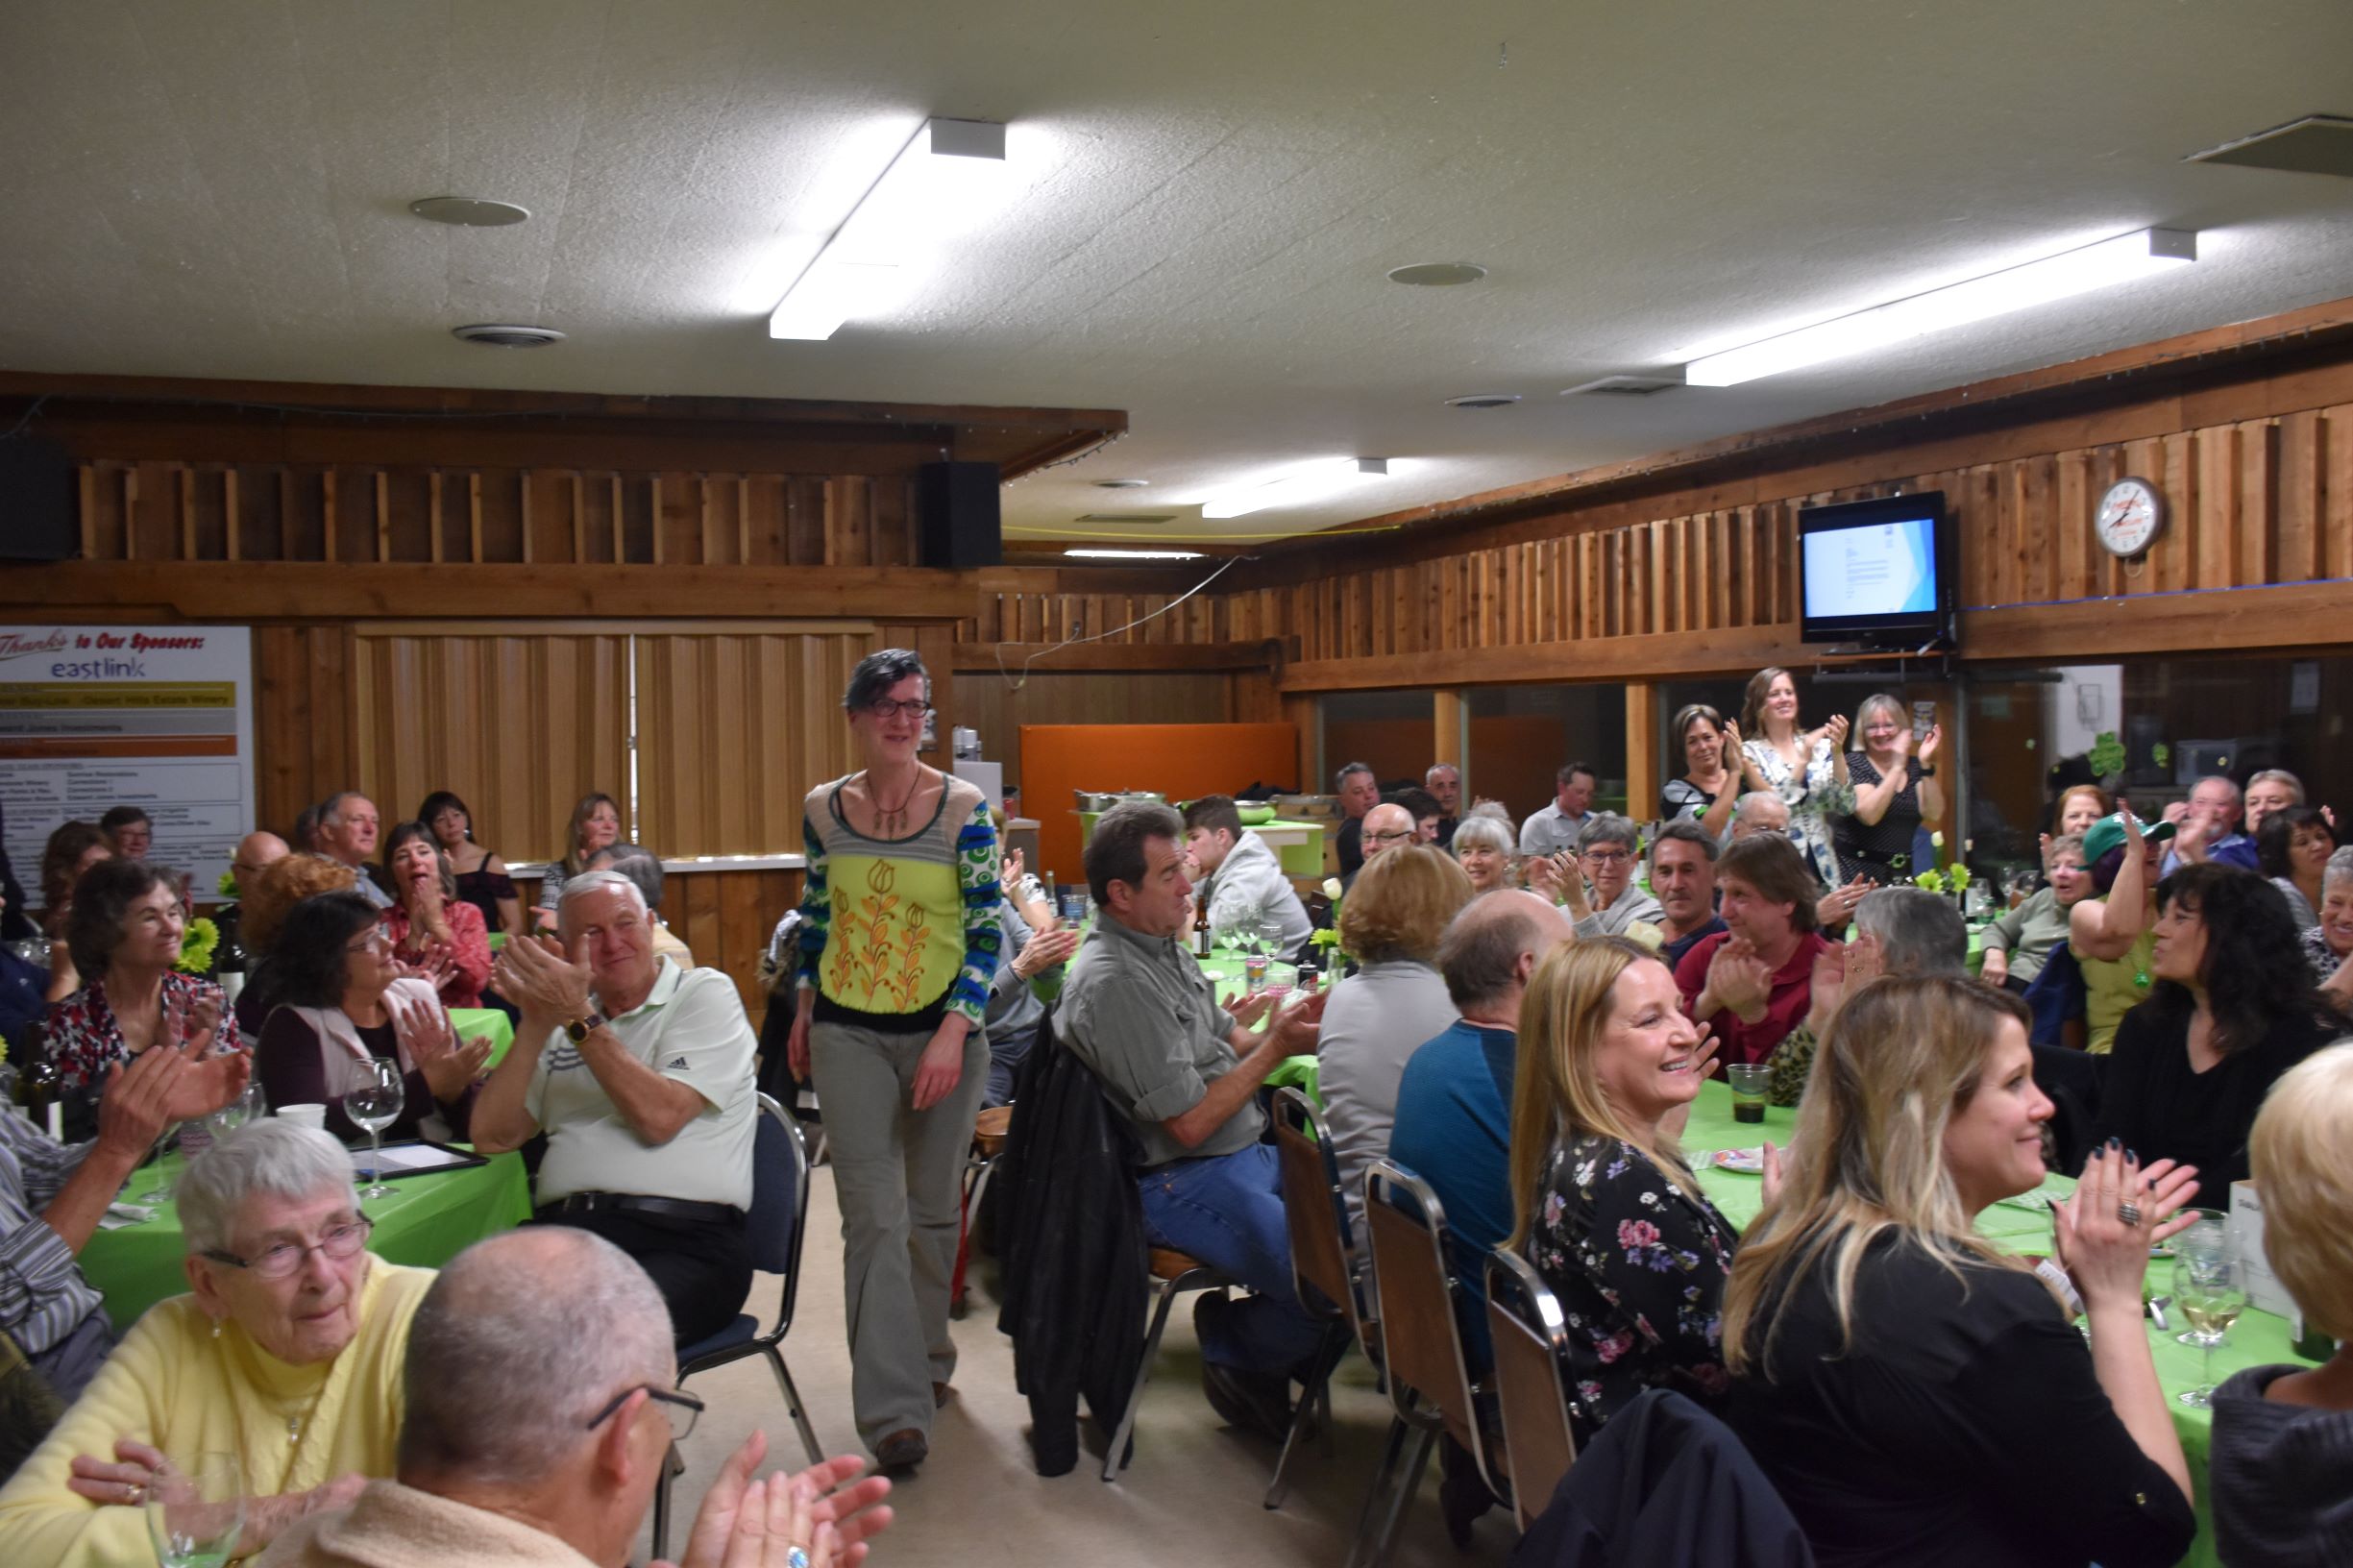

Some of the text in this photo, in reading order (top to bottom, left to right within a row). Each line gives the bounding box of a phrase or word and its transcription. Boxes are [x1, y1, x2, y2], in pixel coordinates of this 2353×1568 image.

[75, 634, 92, 649] to
[97, 632, 126, 649] Our
[130, 633, 206, 653] Sponsors:
[51, 656, 147, 680] eastlink
